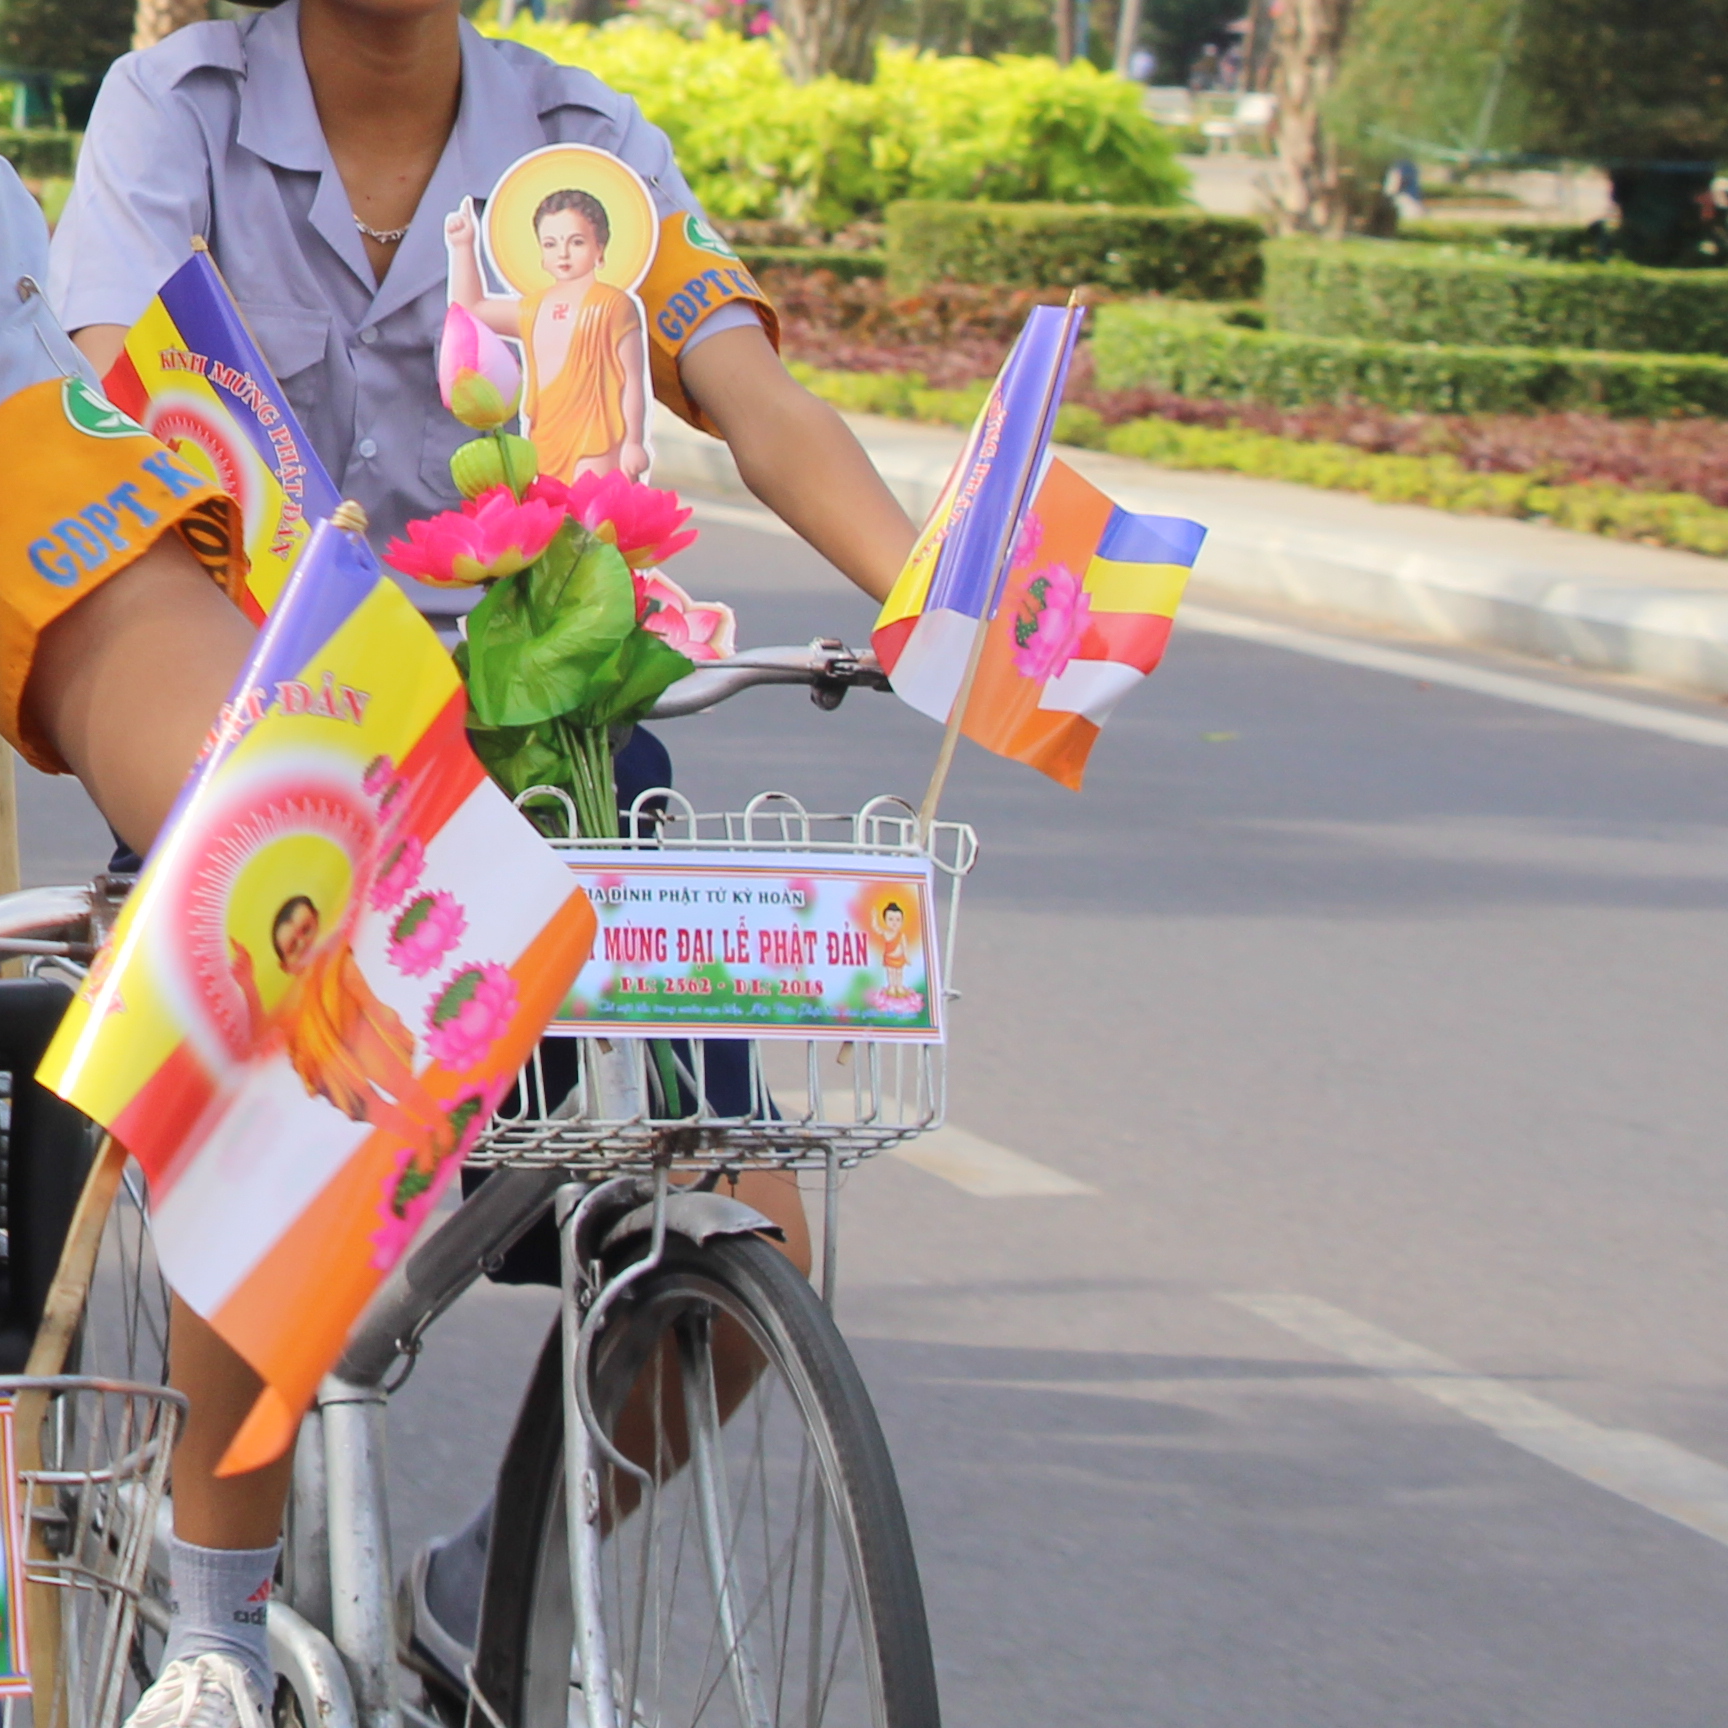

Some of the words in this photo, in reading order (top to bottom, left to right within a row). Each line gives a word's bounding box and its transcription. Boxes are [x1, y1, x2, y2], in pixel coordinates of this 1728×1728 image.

[27, 480, 161, 589] GĐPT
[611, 884, 653, 902] ĐÌNH
[659, 886, 700, 906] PHẬT
[758, 887, 804, 905] HOÀN
[676, 927, 714, 971] ĐẠI
[722, 915, 750, 964] LỄ
[758, 922, 818, 972] PHẬT
[826, 920, 869, 967] ĐẢN
[664, 977, 712, 994] 2562
[778, 978, 825, 995] 2018
